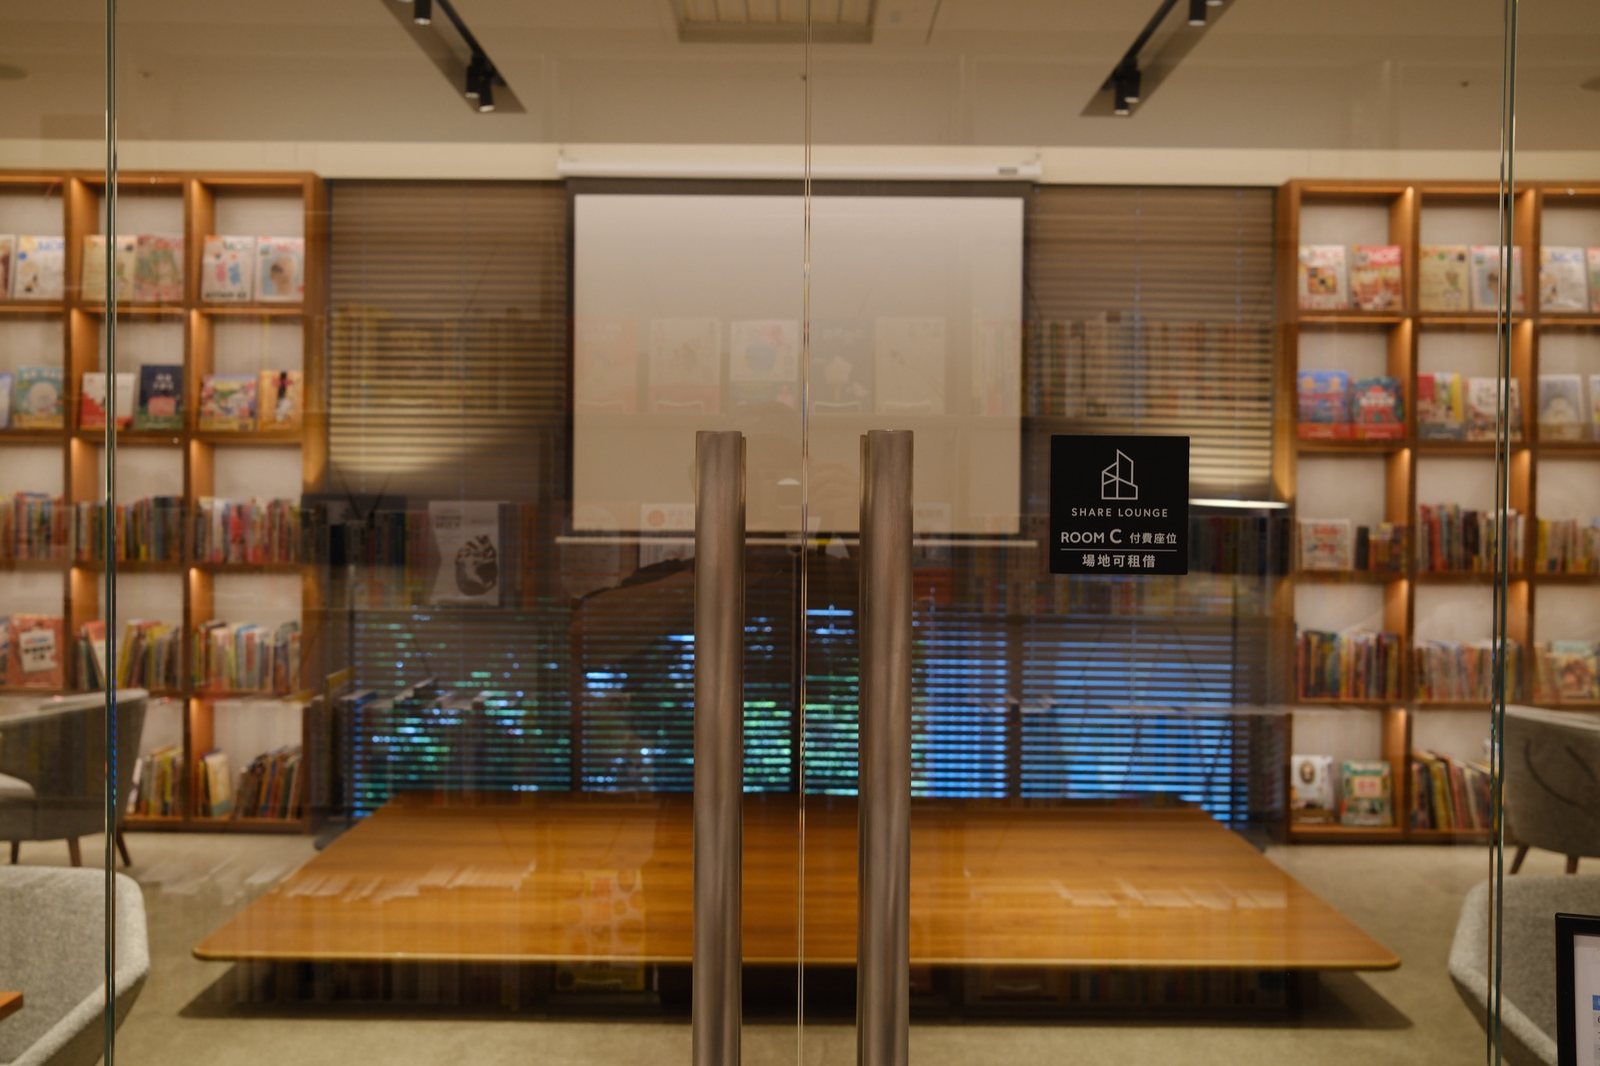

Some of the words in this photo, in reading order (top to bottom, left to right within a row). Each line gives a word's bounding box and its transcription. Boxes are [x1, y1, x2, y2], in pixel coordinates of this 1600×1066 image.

[1071, 507, 1112, 517] SHARE
[1118, 508, 1168, 518] LOUNGE
[1060, 531, 1105, 544] ROOM
[1109, 528, 1122, 544] C
[1129, 532, 1177, 545] 付費座位
[1082, 553, 1156, 568] 場地可租借
